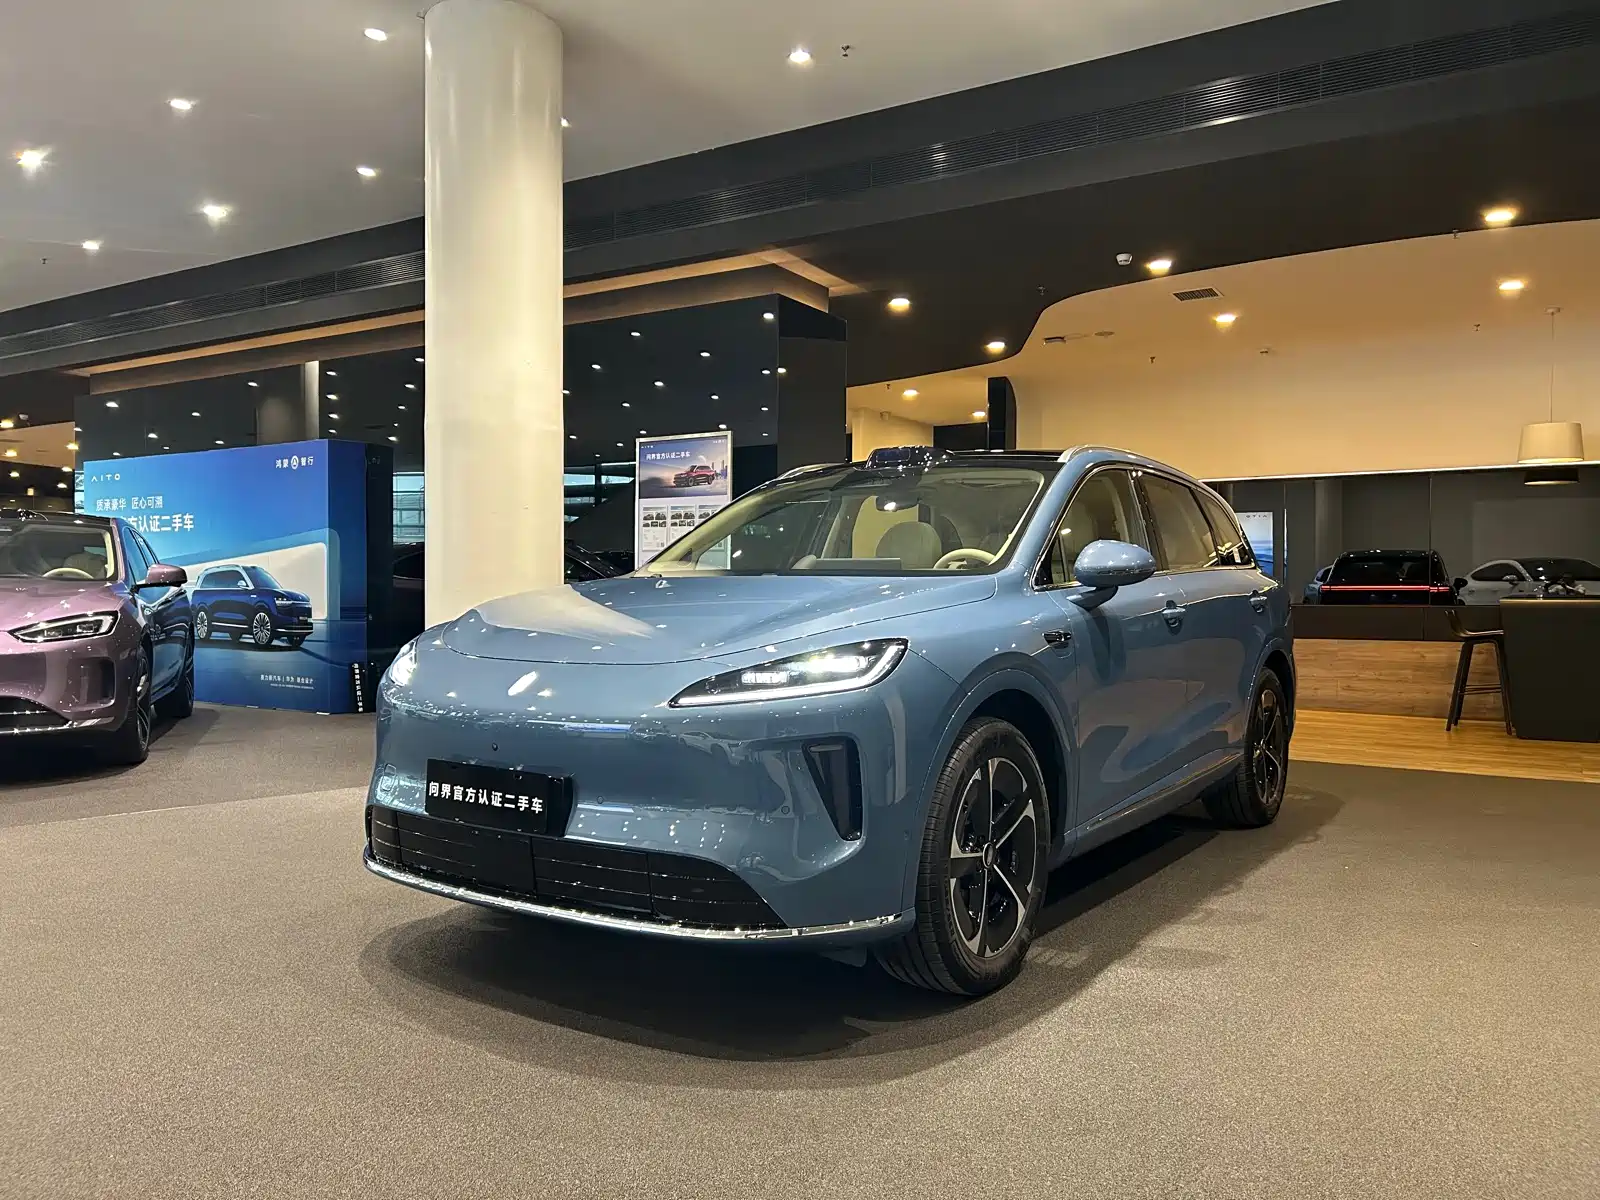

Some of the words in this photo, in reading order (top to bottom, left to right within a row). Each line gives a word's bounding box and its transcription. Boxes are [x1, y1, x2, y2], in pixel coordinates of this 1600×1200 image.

[301, 456, 314, 466] 智行
[91, 473, 120, 482] AITO
[96, 498, 127, 512] 质承豪华
[131, 496, 163, 509] 匠心可溯
[428, 781, 543, 814] 问界官方认证二手车
